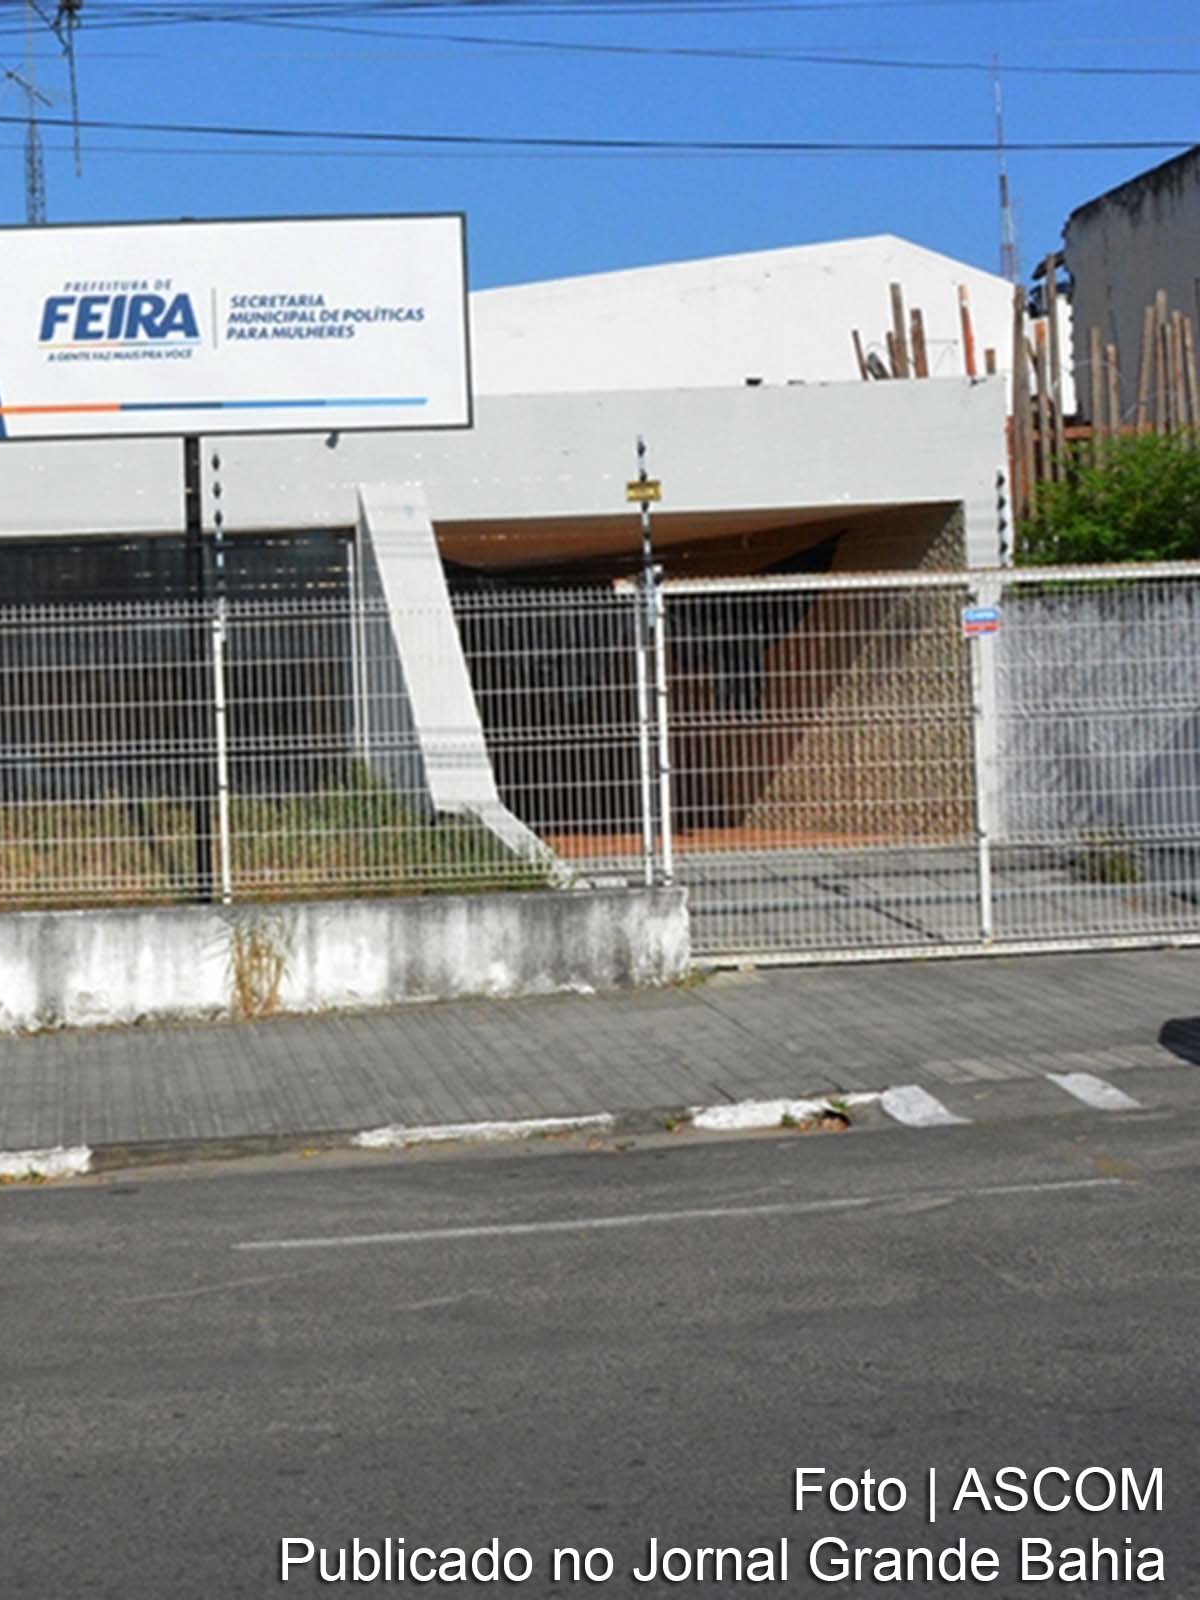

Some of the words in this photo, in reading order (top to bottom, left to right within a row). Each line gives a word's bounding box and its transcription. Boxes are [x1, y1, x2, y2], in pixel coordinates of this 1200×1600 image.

[64, 281, 148, 292] PREFEITURA
[155, 279, 172, 290] DE
[231, 295, 325, 308] SECRETARIA
[39, 293, 199, 341] FEIRA
[228, 310, 316, 324] MUNICIPAL
[319, 309, 338, 322] DE
[343, 306, 424, 322] POLÍTICAS
[227, 327, 268, 340] PARA
[271, 324, 355, 339] MULHERES
